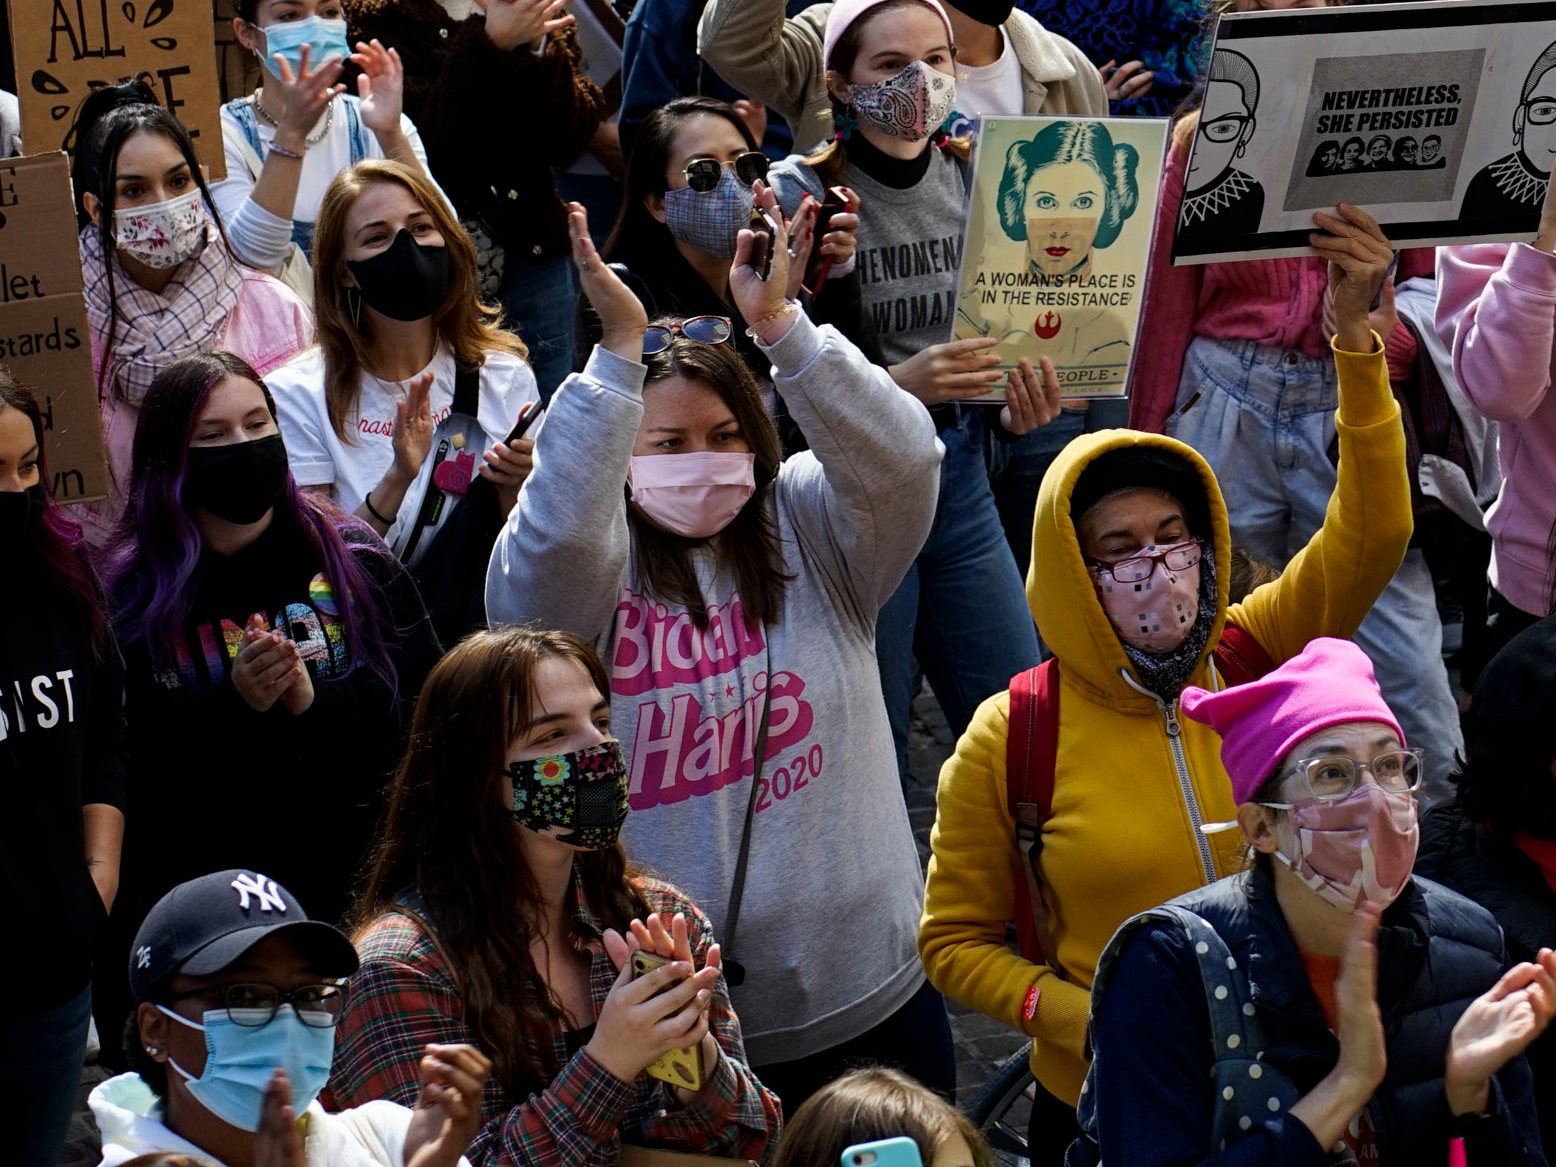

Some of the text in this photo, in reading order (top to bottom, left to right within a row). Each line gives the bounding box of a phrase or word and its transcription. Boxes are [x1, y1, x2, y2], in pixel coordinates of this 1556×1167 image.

[1321, 84, 1462, 111] NEVERTHELESS,
[1316, 107, 1460, 134] SHE PERSISTED
[855, 236, 962, 285] HENOMEN
[975, 271, 1136, 289] A WOMAN'S PLACE IS
[981, 290, 1130, 307] IN THE RESISTANCE
[1056, 369, 1110, 383] EOPLE
[357, 417, 394, 438] nast
[612, 589, 765, 694] Biden
[628, 672, 814, 811] Harris
[754, 743, 824, 814] 2020
[230, 873, 287, 913] NY
